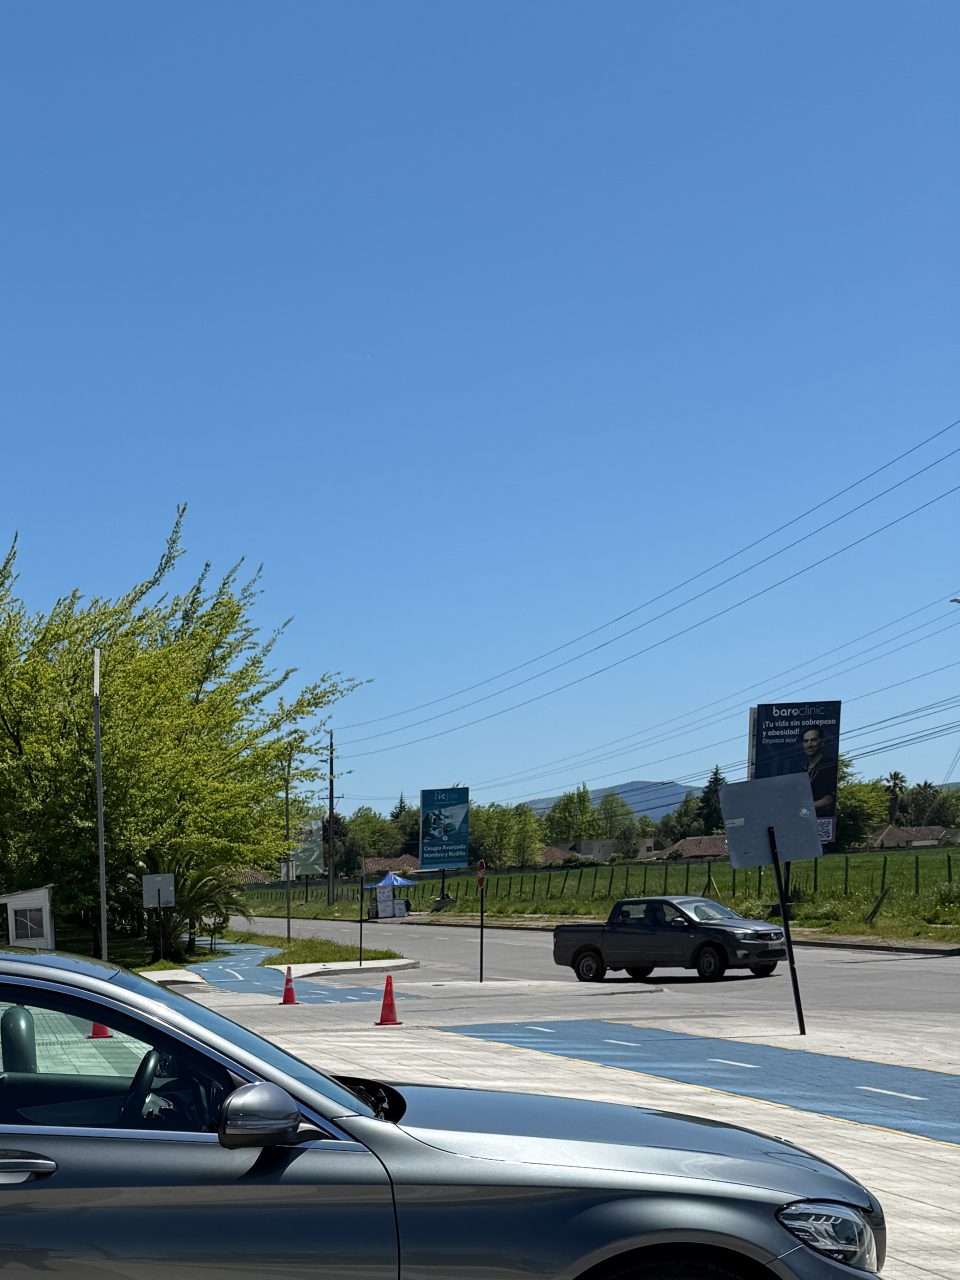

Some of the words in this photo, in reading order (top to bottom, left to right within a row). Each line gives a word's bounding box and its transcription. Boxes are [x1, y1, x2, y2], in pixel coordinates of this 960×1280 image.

[790, 719, 800, 727] sin
[801, 719, 836, 727] sobrepeso
[767, 728, 800, 737] obesidad!
